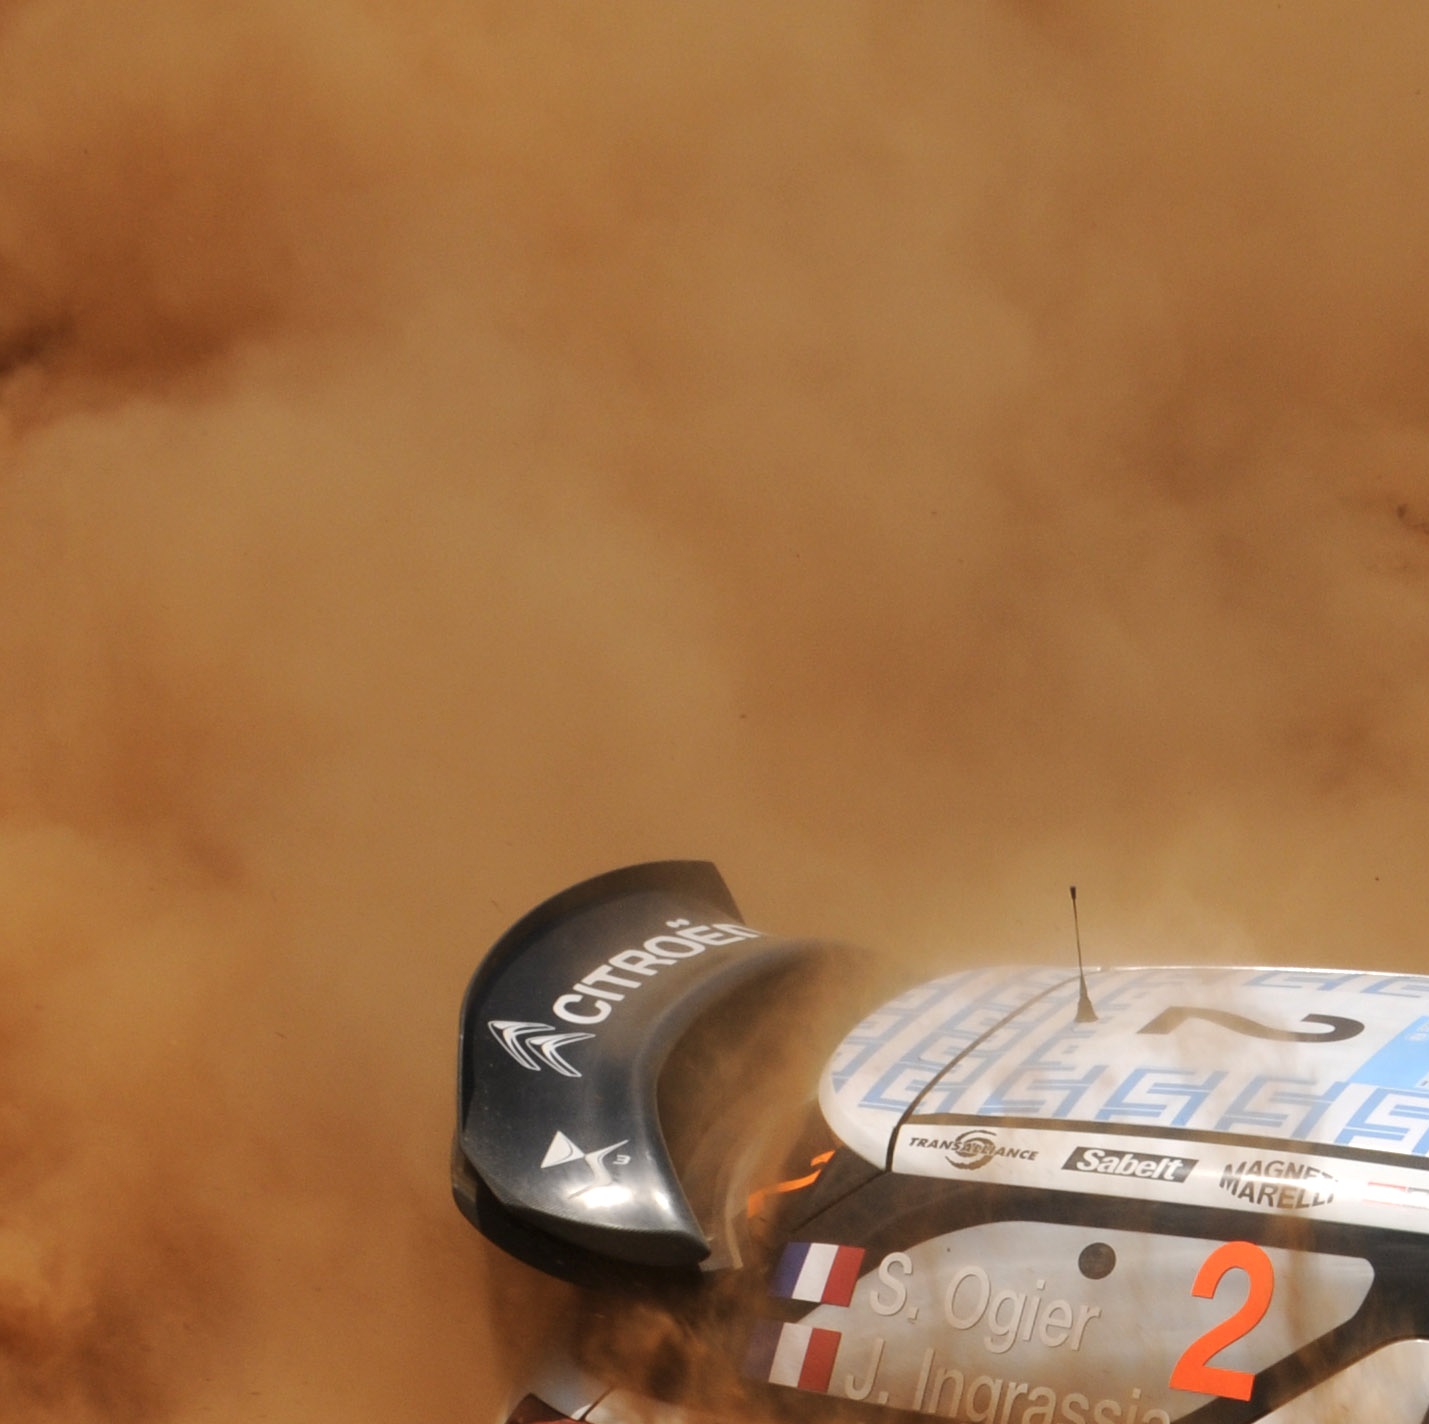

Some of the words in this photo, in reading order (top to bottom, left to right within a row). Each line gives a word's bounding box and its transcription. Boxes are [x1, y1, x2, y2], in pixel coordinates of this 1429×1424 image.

[1076, 1148, 1184, 1182] Sabelt
[1222, 1160, 1339, 1182] MAGNE
[869, 1251, 919, 1321] S.
[944, 1265, 1102, 1354] Ogier
[1168, 1240, 1275, 1402] 2
[844, 1338, 889, 1404] J.
